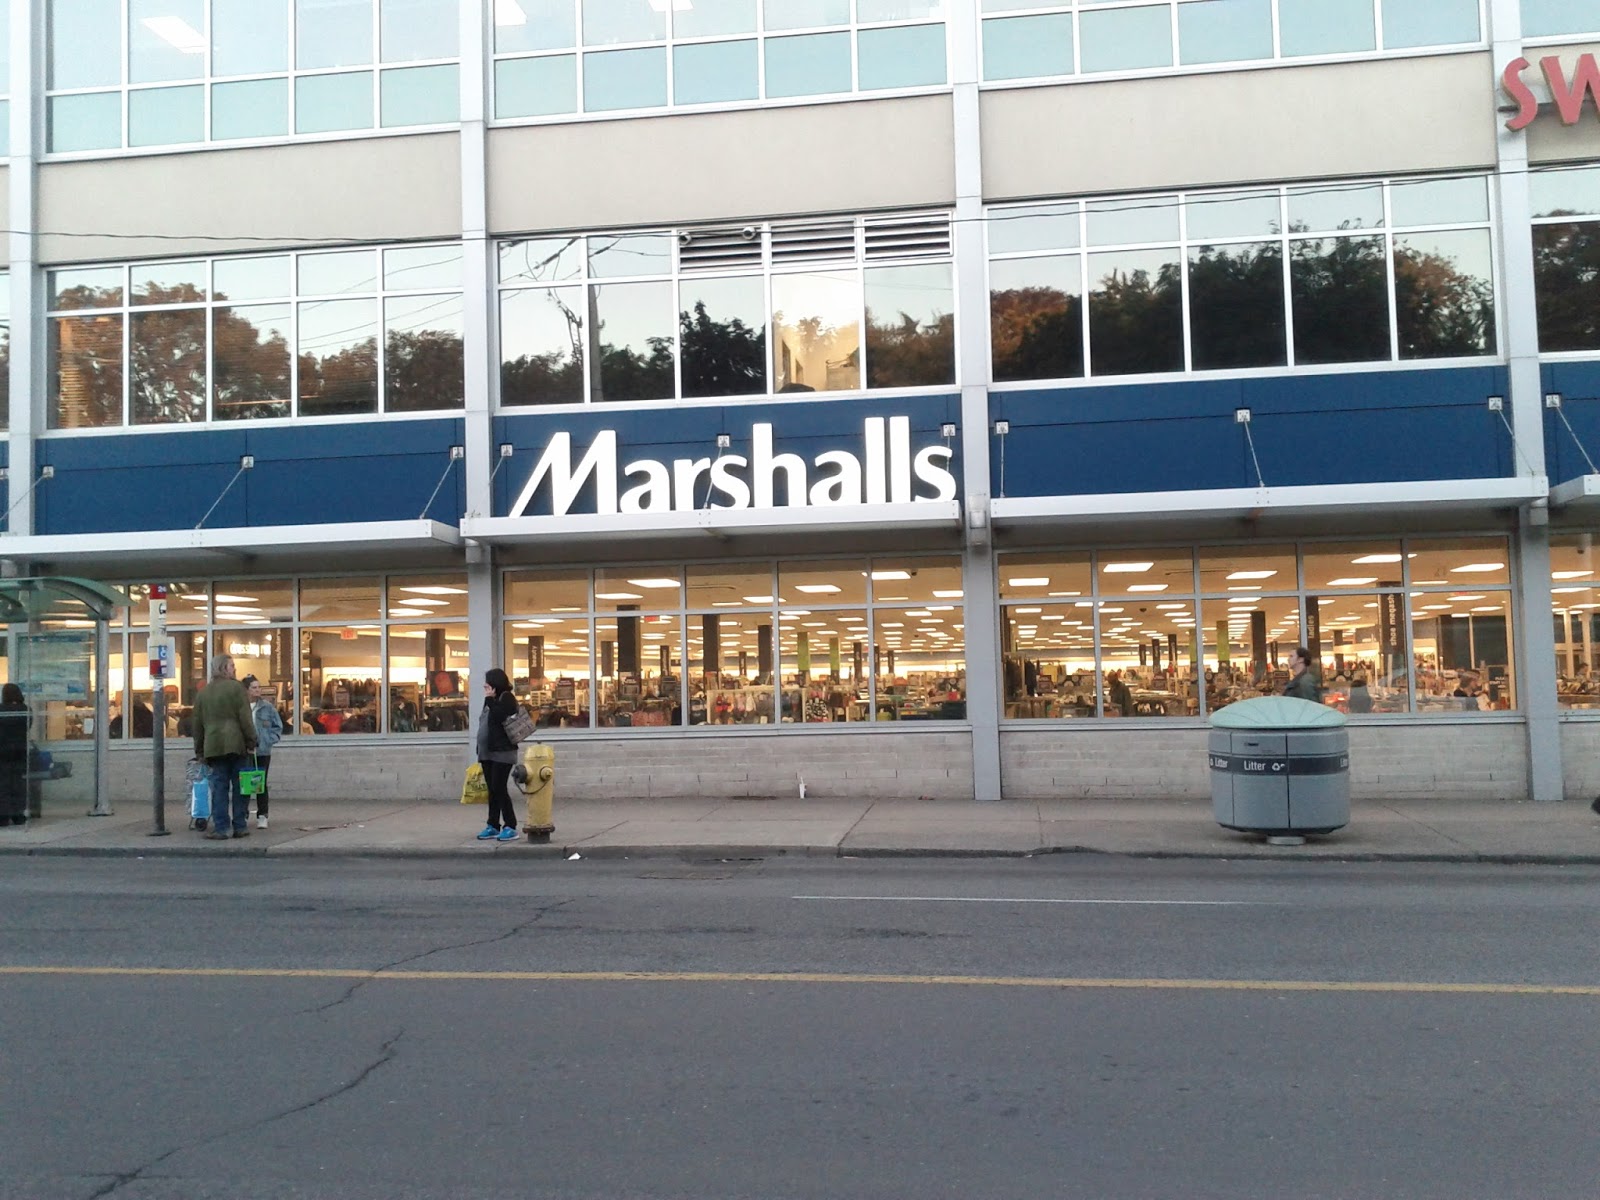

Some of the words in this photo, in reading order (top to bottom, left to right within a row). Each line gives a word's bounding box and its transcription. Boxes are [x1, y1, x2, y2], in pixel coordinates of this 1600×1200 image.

[509, 416, 957, 519] Marshalls
[1387, 594, 1396, 625] megash
[1215, 757, 1228, 768] Litter
[1243, 760, 1267, 771] Litter
